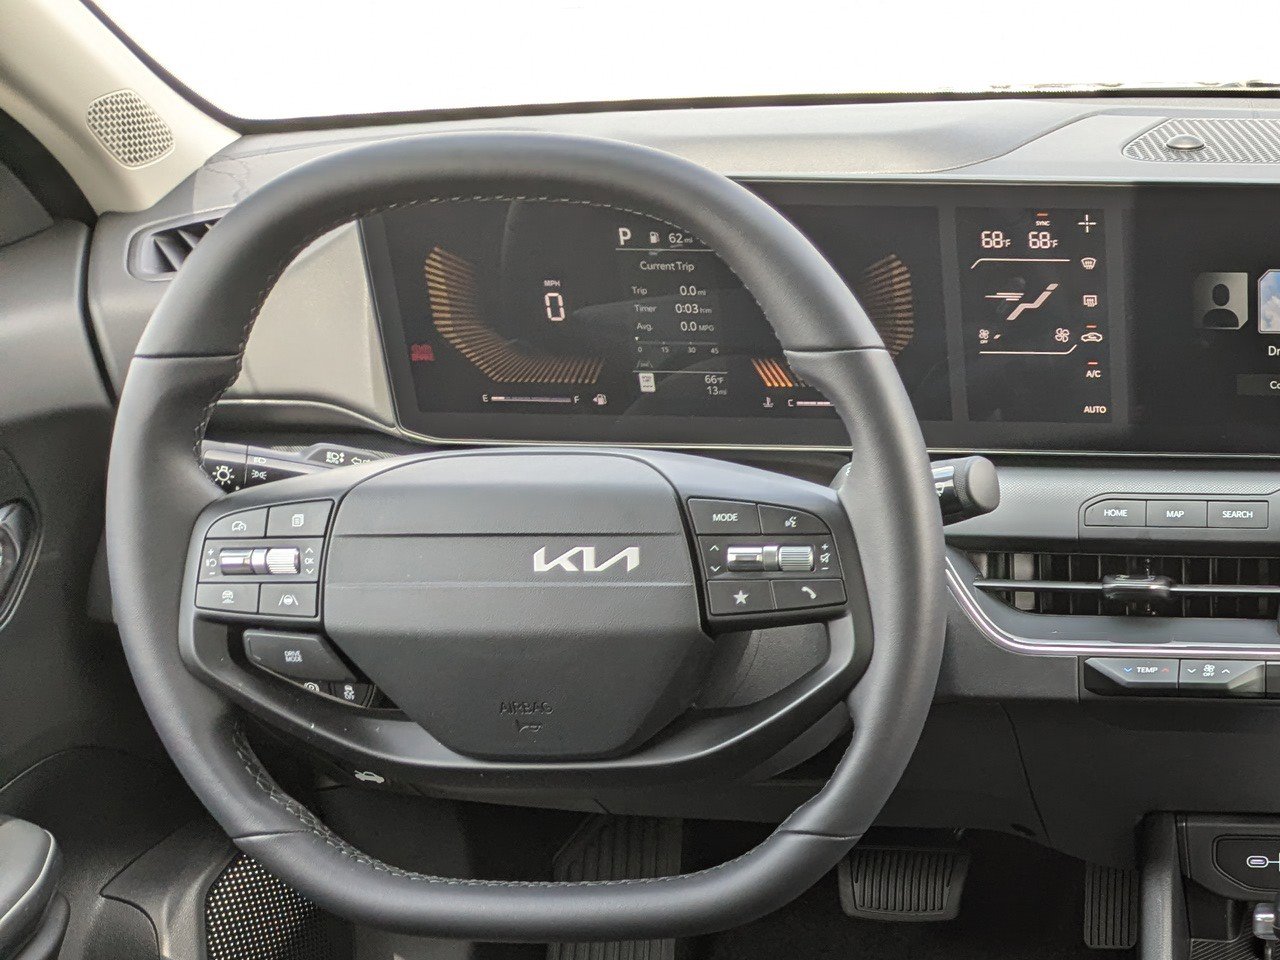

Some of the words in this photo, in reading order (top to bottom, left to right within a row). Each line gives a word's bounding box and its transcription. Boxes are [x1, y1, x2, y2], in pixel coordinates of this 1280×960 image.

[618, 227, 632, 245] P
[668, 233, 683, 243] 62
[640, 261, 675, 270] Current
[676, 261, 695, 272] Trip
[631, 286, 648, 295] Trip
[680, 285, 697, 296] 0.0
[544, 292, 565, 322] 0
[634, 304, 657, 312] Timer
[675, 303, 699, 314] 0:03
[637, 323, 653, 331] Avg.
[680, 321, 697, 331] 0.0
[1086, 370, 1101, 378] A/C
[482, 394, 489, 402] E
[1083, 405, 1107, 414] AUTO
[712, 513, 738, 522] MODE
[1104, 509, 1127, 517] HOME
[1166, 510, 1184, 518] MAP
[1222, 510, 1253, 518] SEARCH
[534, 547, 639, 572] KIA
